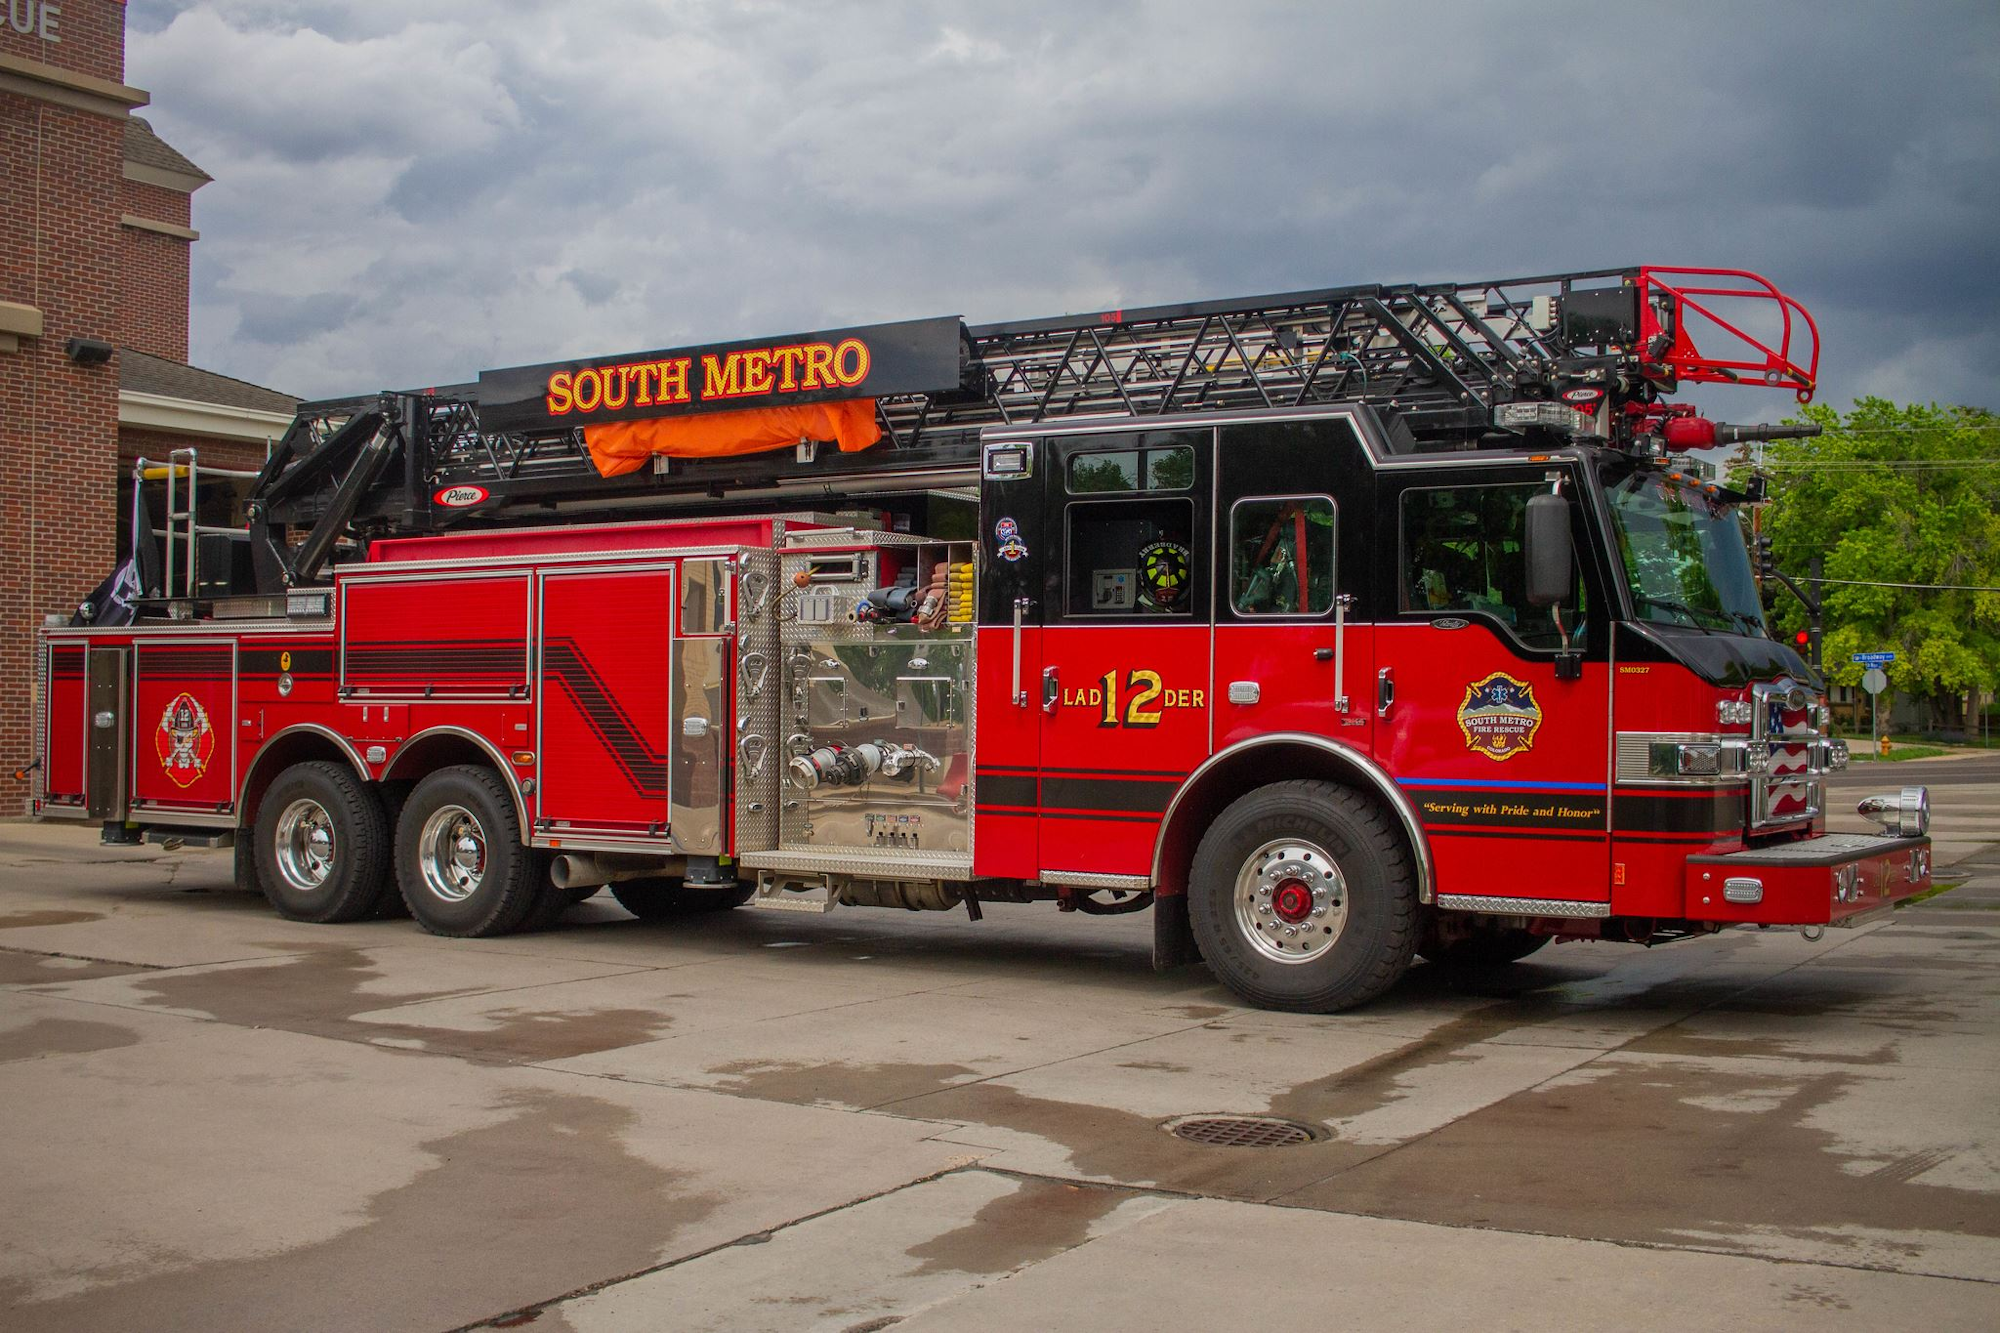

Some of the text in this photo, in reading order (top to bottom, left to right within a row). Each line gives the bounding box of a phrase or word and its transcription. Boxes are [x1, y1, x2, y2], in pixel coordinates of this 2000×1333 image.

[0, 0, 62, 43] UE
[547, 338, 870, 416] SOUTH METRO
[446, 489, 477, 503] Pierce
[1619, 666, 1650, 674] SM0327
[1063, 669, 1205, 727] LAD 12 DER
[180, 709, 190, 721] 12
[1465, 716, 1534, 728] SOUTH METRO
[1473, 725, 1525, 734] FIRE RESCUE
[1486, 745, 1511, 754] COLORADO
[1473, 803, 1497, 815] with
[1500, 805, 1529, 816] Pride
[1532, 806, 1555, 817] and
